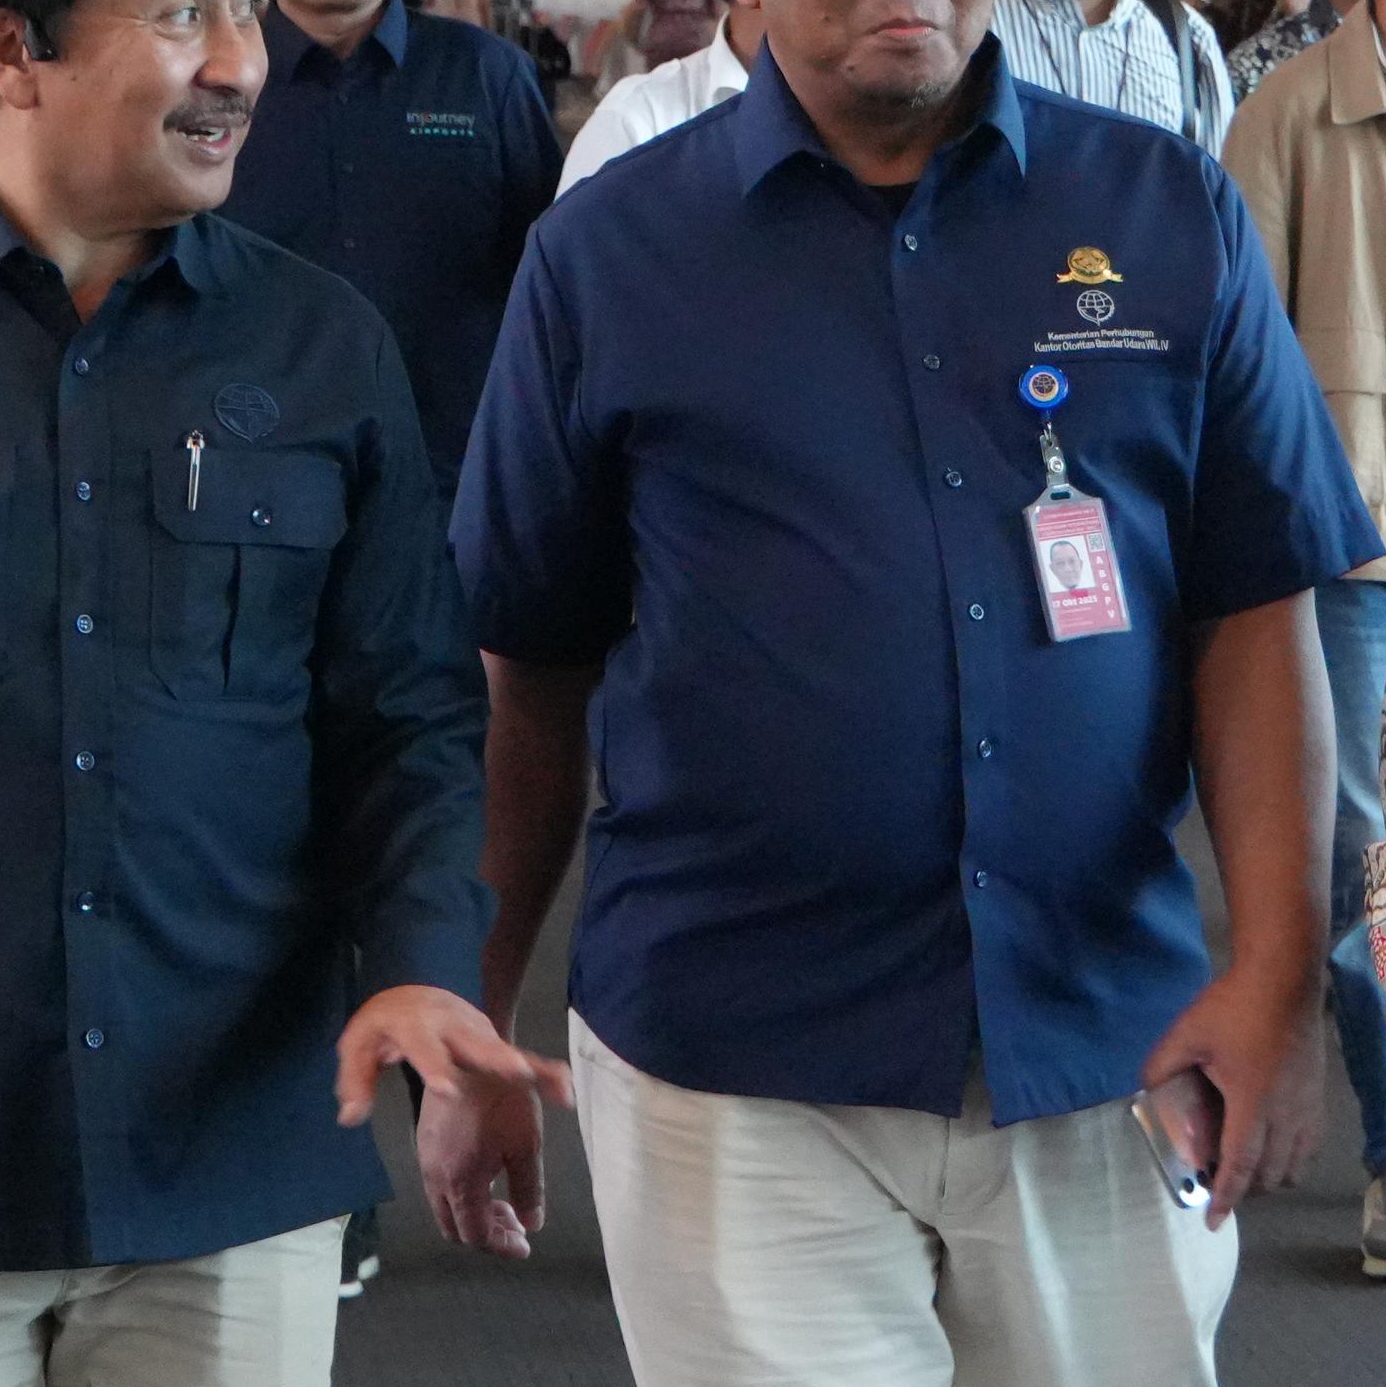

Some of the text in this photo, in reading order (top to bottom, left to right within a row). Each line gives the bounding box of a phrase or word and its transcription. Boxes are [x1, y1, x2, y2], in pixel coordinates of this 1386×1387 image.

[1034, 341, 1062, 353] Kantor
[1062, 340, 1095, 351] Otoritas
[1096, 556, 1104, 565] A
